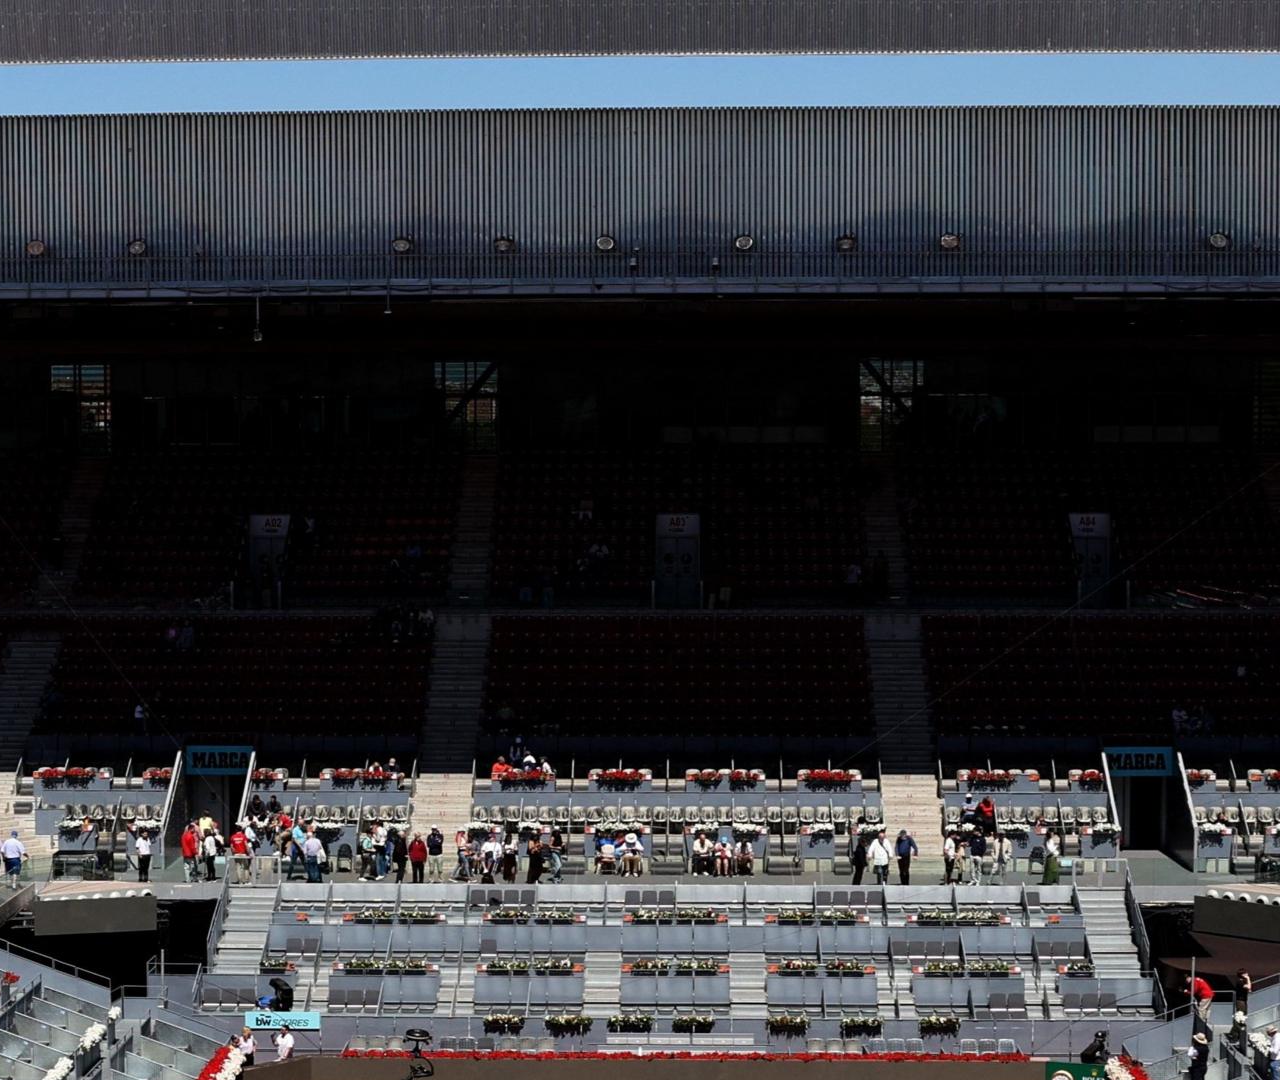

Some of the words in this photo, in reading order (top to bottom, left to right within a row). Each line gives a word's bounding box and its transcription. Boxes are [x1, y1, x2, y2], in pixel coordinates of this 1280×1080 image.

[191, 751, 250, 769] MARCA
[1107, 752, 1167, 770] MARCA
[272, 1019, 310, 1027] SCORES
